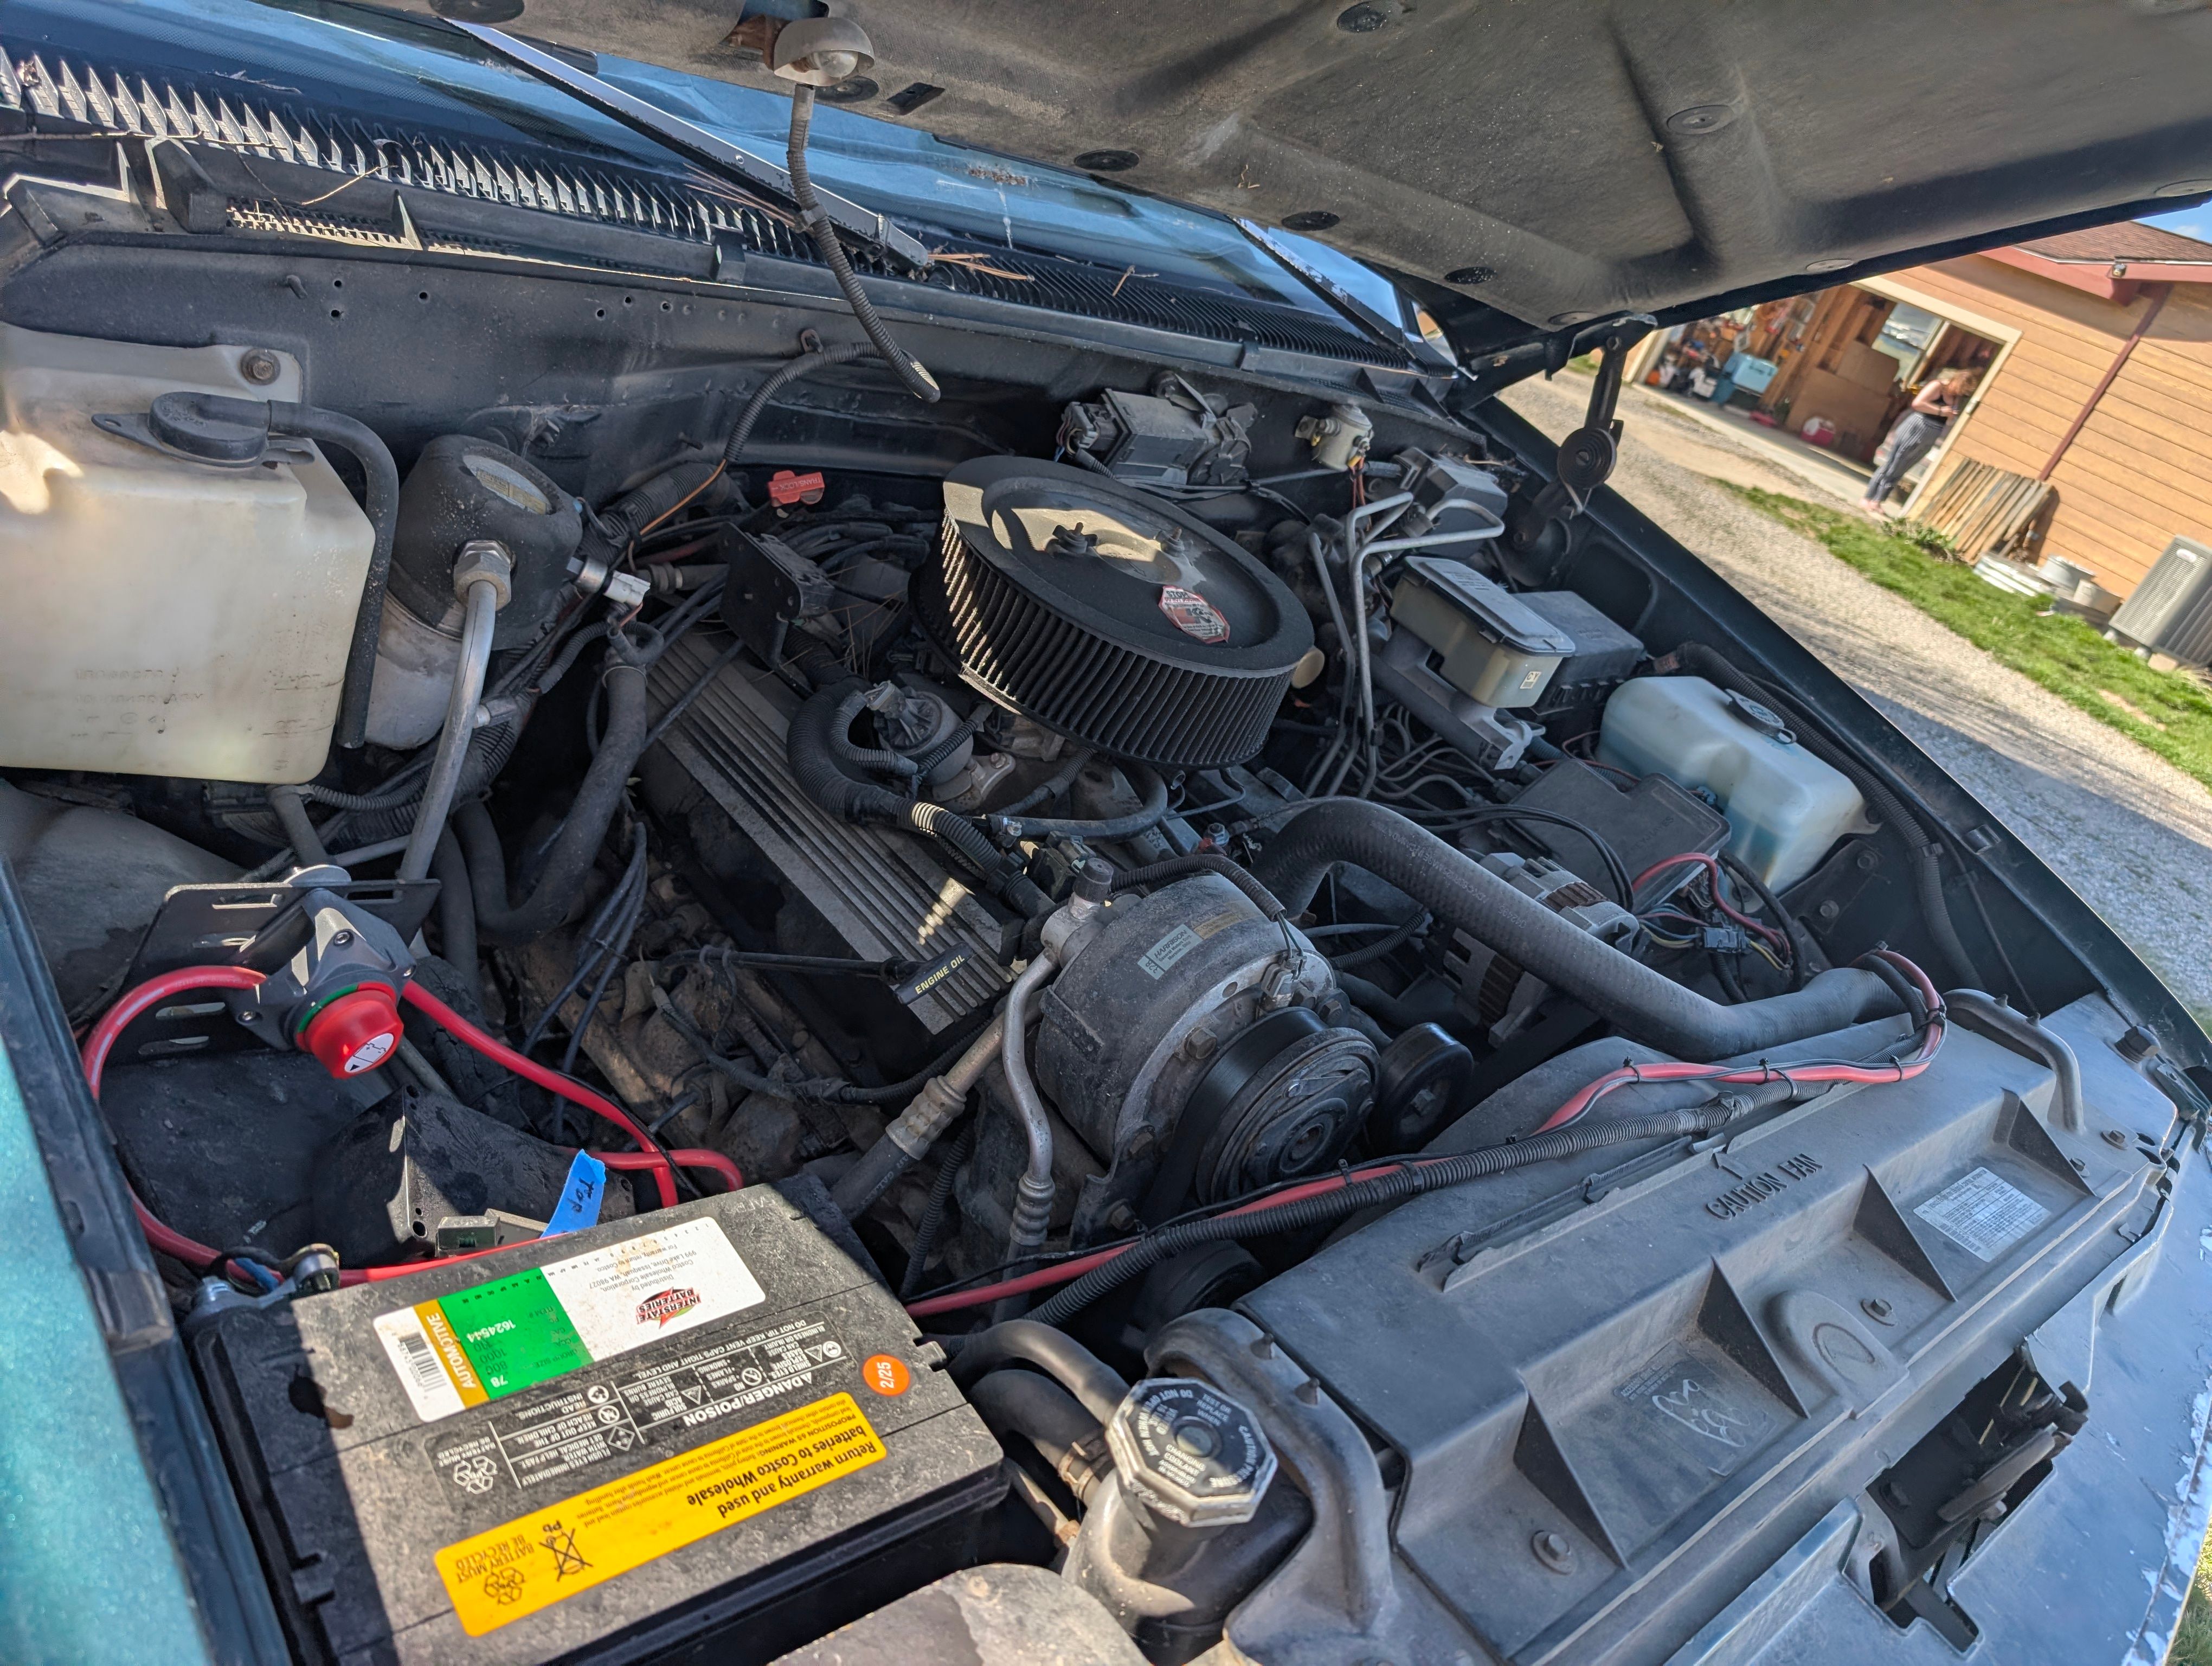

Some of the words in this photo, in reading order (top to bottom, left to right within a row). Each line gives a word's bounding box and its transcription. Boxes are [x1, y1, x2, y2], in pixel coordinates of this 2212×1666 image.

[1153, 928, 1188, 959] HARRISON
[1158, 949, 1173, 962] General
[1171, 940, 1184, 951] Motors
[913, 965, 951, 994] ENGINE
[948, 953, 966, 969] OIL
[1706, 1171, 1789, 1221] CAUTION
[1777, 1153, 1824, 1188] FAN
[641, 1246, 668, 1259] warranty,
[666, 1242, 678, 1251] For
[683, 1248, 697, 1258] 999
[616, 1258, 626, 1266] to
[623, 1253, 643, 1264] return
[650, 1257, 669, 1268] Drive,
[667, 1253, 685, 1263] Lake
[670, 1258, 694, 1270] Costco
[594, 1260, 619, 1273] Costco.
[619, 1263, 652, 1278] Issaquah,
[639, 1265, 672, 1280] Wholesale
[587, 1276, 609, 1289] 98027
[599, 1275, 640, 1293] Corporation,
[607, 1272, 621, 1282] WA
[638, 1272, 674, 1289] Distributed
[629, 1283, 640, 1292] by
[636, 1288, 695, 1313] BATTERIES
[533, 1305, 554, 1316] ITEM
[635, 1295, 702, 1323] INTERSTATE
[465, 1318, 517, 1343] 1624544
[779, 1322, 795, 1333] NOT
[794, 1318, 806, 1328] DO
[744, 1332, 766, 1344] KEEP
[765, 1328, 778, 1337] TIP.
[783, 1335, 794, 1344] OR
[793, 1324, 825, 1341] BLINDNESS
[424, 1310, 477, 1393] AUTOMOTIVE
[724, 1338, 745, 1351] VENT
[761, 1337, 785, 1351] INJURY.
[766, 1344, 787, 1357] CAUSE
[786, 1341, 799, 1350] CAN
[550, 1347, 578, 1362] GROUP
[703, 1345, 725, 1359] CAPS
[780, 1347, 803, 1360] GASES
[483, 1359, 509, 1376] 800
[661, 1360, 680, 1373] AND
[679, 1353, 703, 1367] TIGHT
[770, 1353, 807, 1371] EXPLOSIVE
[788, 1359, 812, 1373] SHIELD
[632, 1366, 662, 1382] LEVEL.
[767, 1366, 789, 1380] EYES.
[874, 1359, 897, 1392] 2/25
[488, 1373, 509, 1389] 78
[646, 1375, 672, 1389] SEVERE
[732, 1381, 745, 1392] NO
[620, 1383, 647, 1398] BURNS.
[638, 1381, 676, 1400] BLINDNESS
[663, 1388, 679, 1400] CAN
[1160, 1389, 1179, 1400] NOT
[1180, 1389, 1193, 1399] DO
[514, 1391, 583, 1421] INSTRUCTIONS.
[560, 1399, 587, 1414] READ
[627, 1394, 640, 1404] OR
[642, 1393, 665, 1407] CAUSE
[664, 1395, 683, 1408] ACID
[682, 1375, 804, 1427] DANGER/POISON
[1202, 1393, 1219, 1407] TEST
[1219, 1404, 1232, 1414] OR
[650, 1401, 687, 1421] SULFURIC
[1197, 1399, 1229, 1422] REPLACE
[1197, 1408, 1221, 1426] WHEN
[555, 1420, 567, 1431] OF
[565, 1412, 593, 1428] REACH
[576, 1419, 597, 1433] KEEP
[806, 1412, 857, 1437] PROPOSITION
[478, 1435, 491, 1445] BE
[513, 1424, 556, 1446] CHILDREN.
[548, 1432, 561, 1443] OF
[560, 1426, 577, 1439] OUT
[588, 1432, 603, 1445] GET
[795, 1432, 807, 1441] 65
[532, 1436, 549, 1448] THE
[557, 1437, 589, 1455] MEDICAL
[586, 1440, 607, 1453] WITH
[755, 1436, 796, 1457] WARNING:
[810, 1424, 867, 1457] batteries
[1142, 1438, 1160, 1456] HOT
[1238, 1425, 1257, 1463] CAUTION
[435, 1439, 479, 1459] RECYCLED
[460, 1441, 497, 1459] BATTERY
[538, 1448, 558, 1462] HELP
[561, 1447, 588, 1463] WATER.
[586, 1446, 611, 1463] FLUSH
[796, 1445, 814, 1462] to
[832, 1440, 877, 1468] Return
[437, 1453, 461, 1468] MUST
[517, 1454, 540, 1469] FAST.
[568, 1455, 588, 1469] EYES
[1163, 1452, 1200, 1476] COOLANT
[1165, 1444, 1206, 1471] CHANGING
[754, 1451, 800, 1480] Costco
[774, 1454, 836, 1491] warranty
[1159, 1459, 1196, 1483] ASSEMBLED
[519, 1462, 570, 1486] IMMEDIATELY
[684, 1469, 759, 1510] Wholesale
[750, 1482, 780, 1504] and
[715, 1493, 753, 1520] used
[541, 1519, 563, 1535] Pb
[511, 1534, 526, 1549] BE
[454, 1540, 511, 1572] RECYCLED
[488, 1542, 535, 1570] BATTERY
[454, 1561, 488, 1584] MUST
